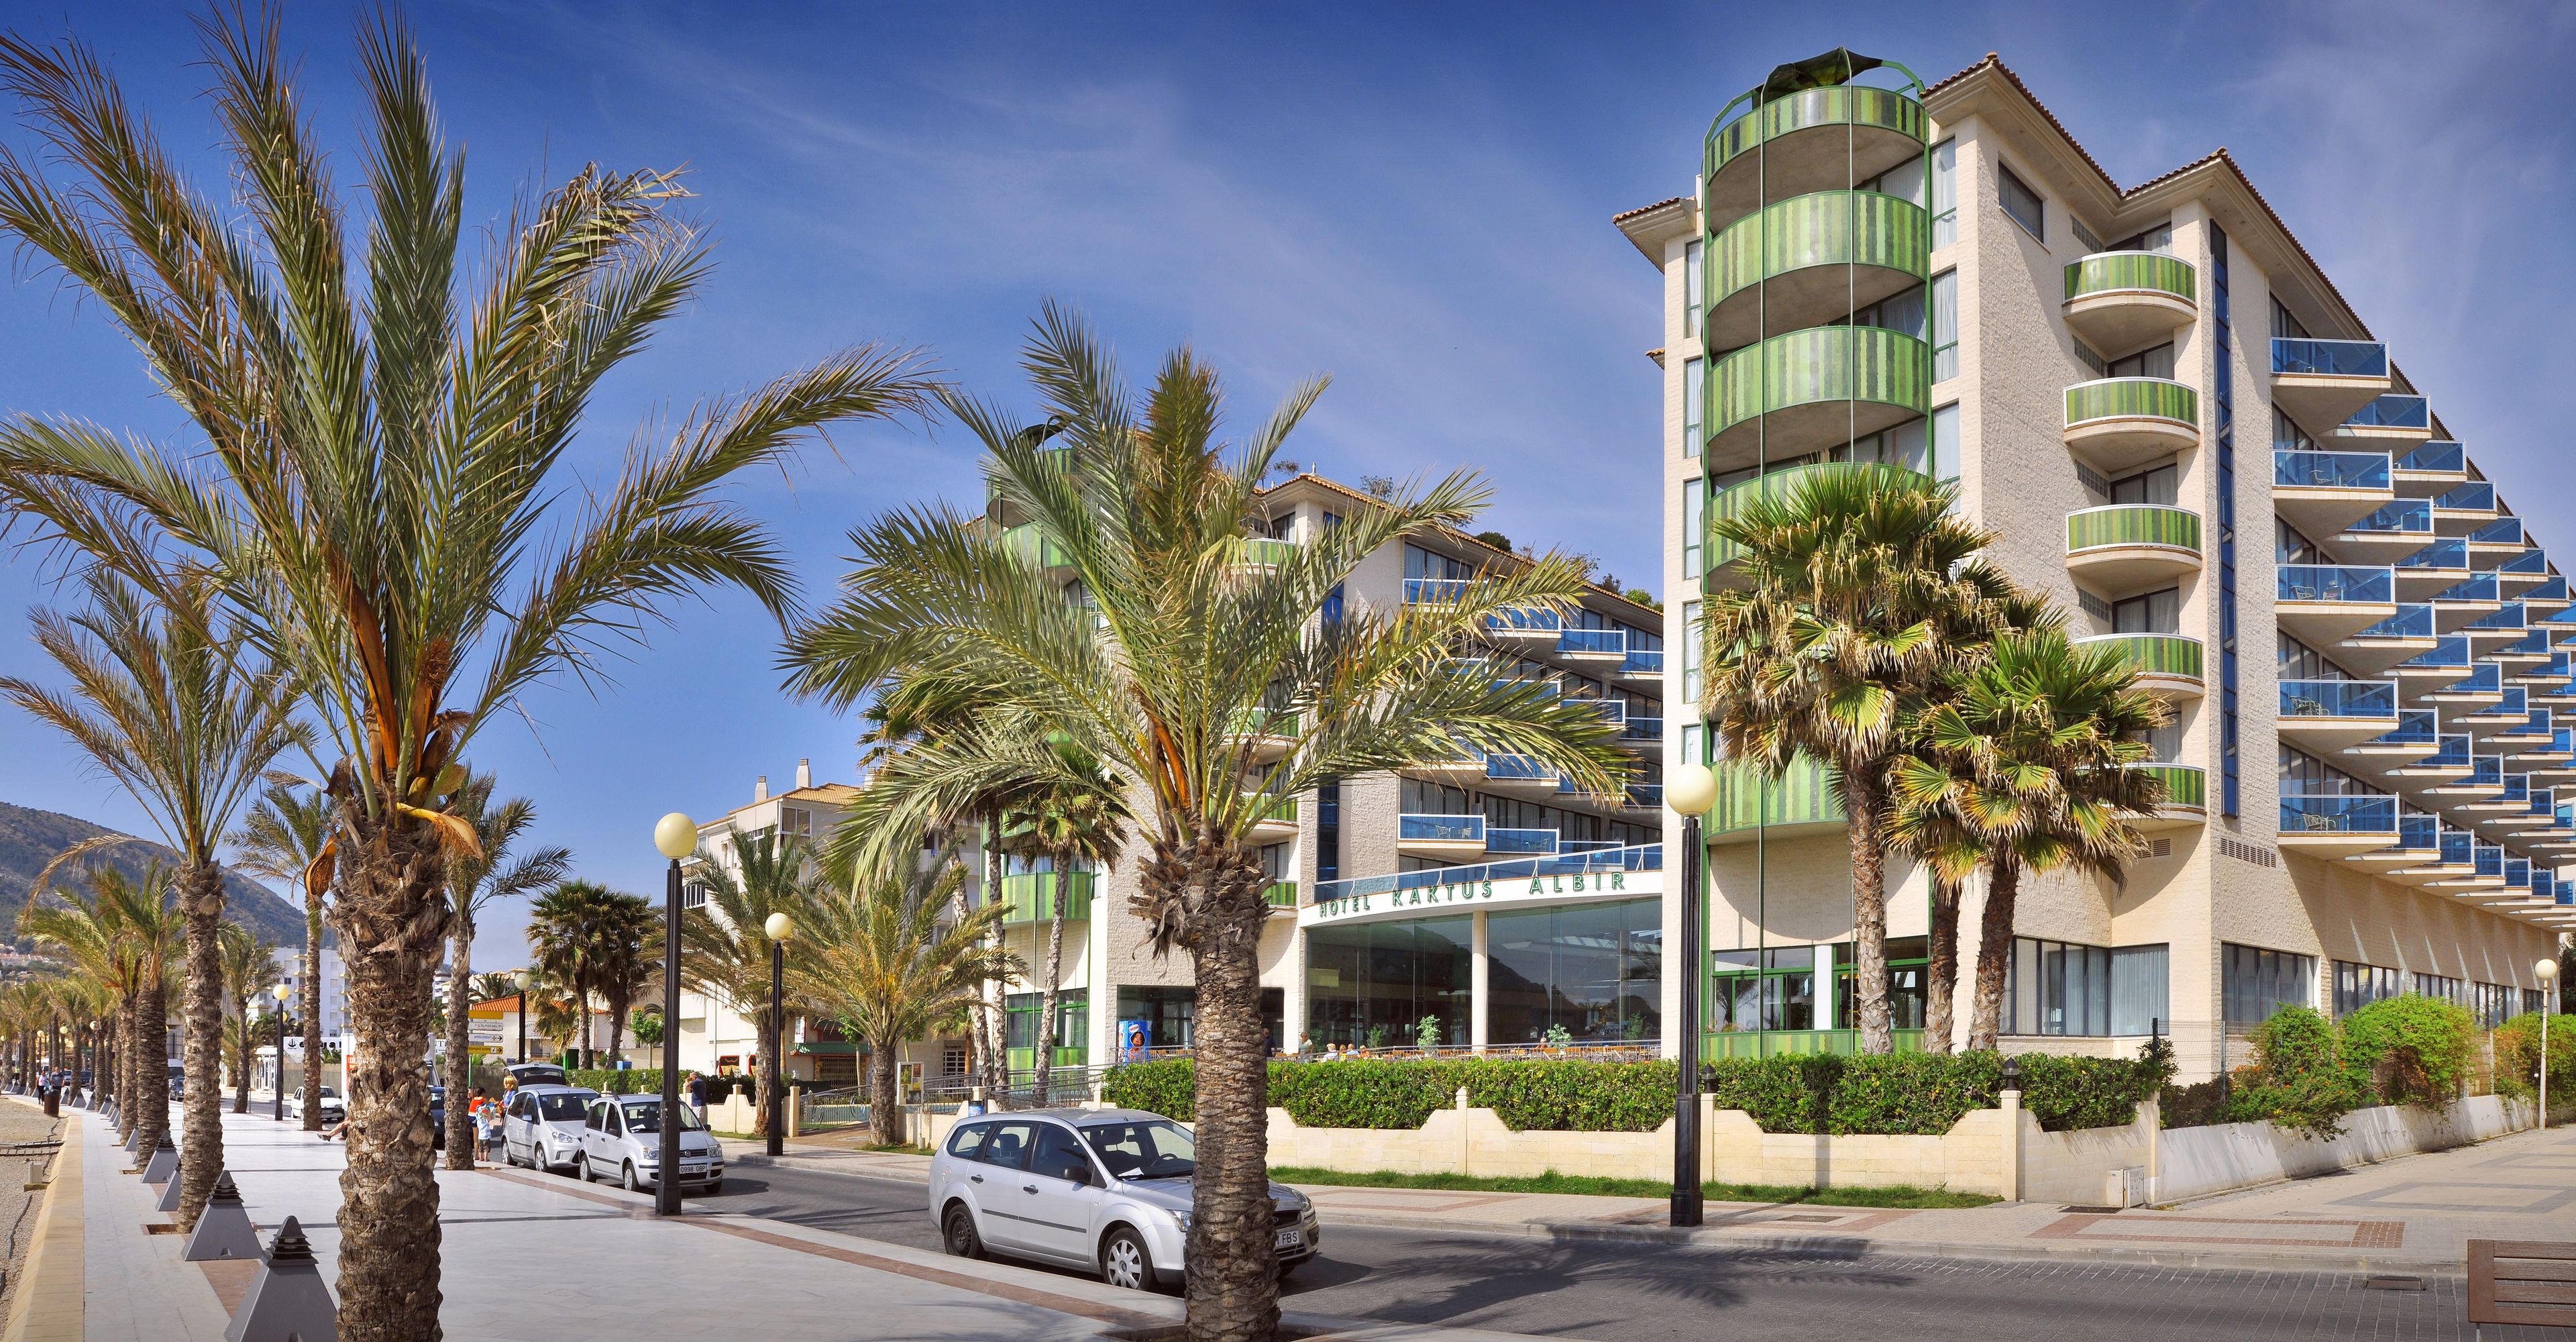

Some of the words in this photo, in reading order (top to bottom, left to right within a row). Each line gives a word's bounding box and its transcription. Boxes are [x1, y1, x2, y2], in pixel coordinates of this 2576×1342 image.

[1320, 894, 1371, 917] HOTEL
[1393, 880, 1493, 906] KAKTUS
[1529, 872, 1625, 894] ALBIR
[1282, 1232, 1297, 1244] FBS
